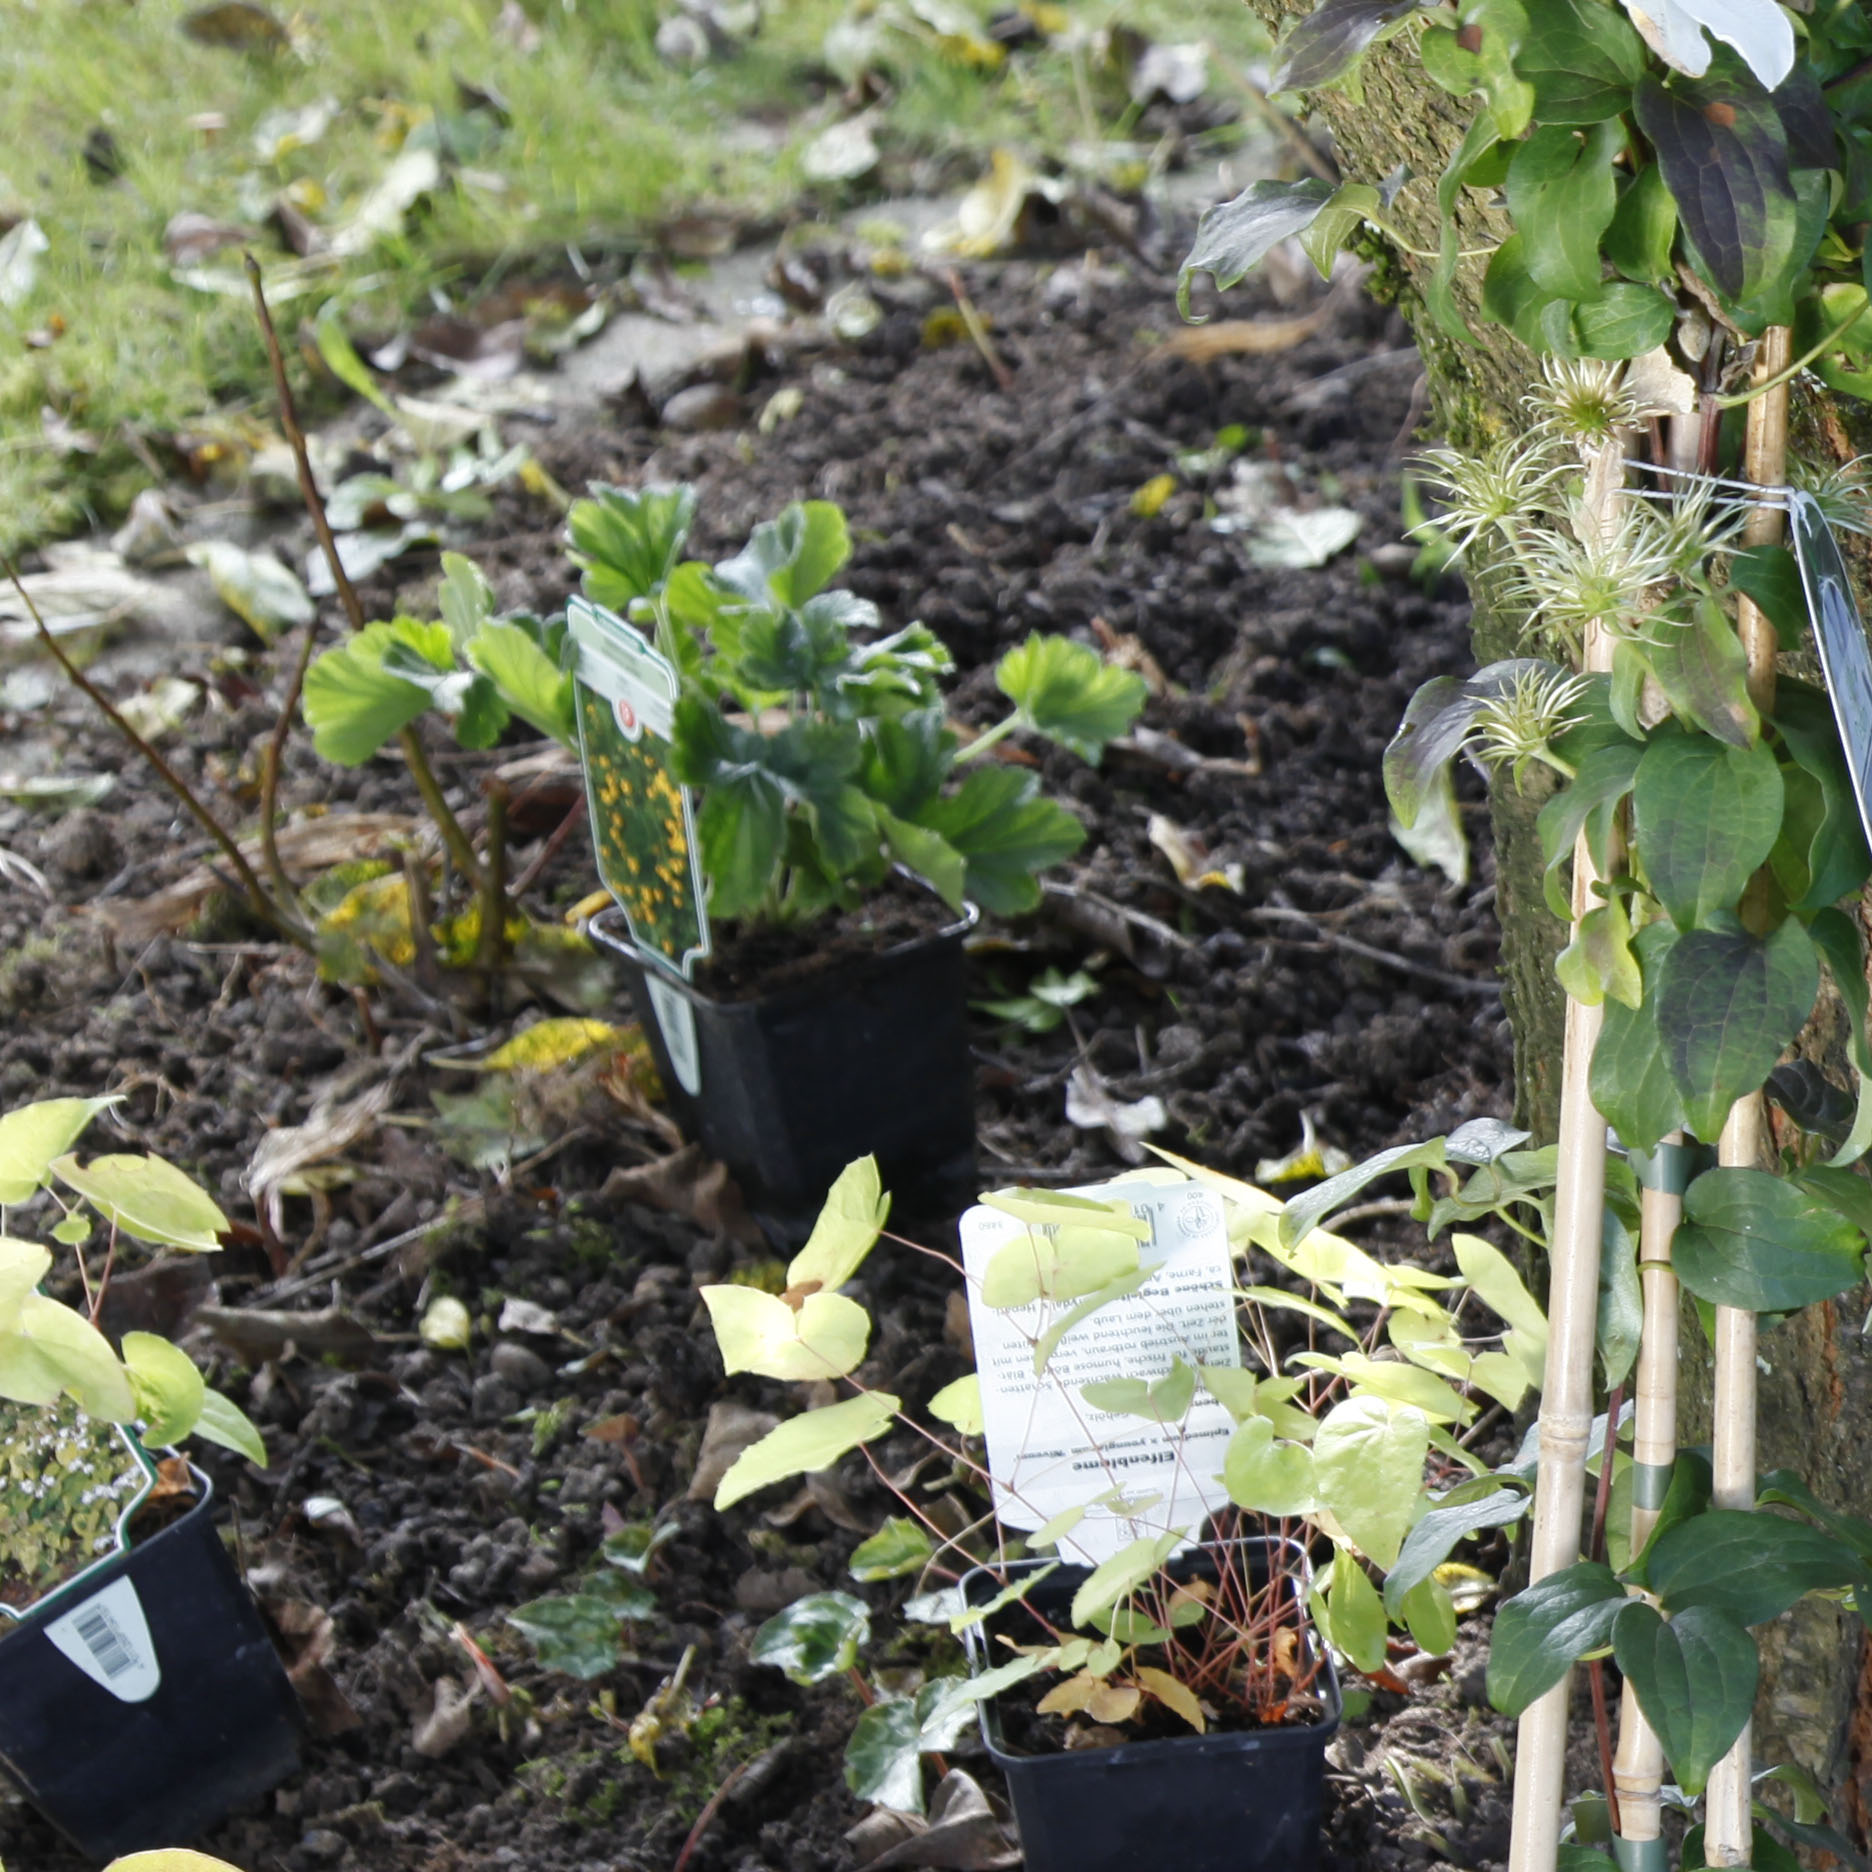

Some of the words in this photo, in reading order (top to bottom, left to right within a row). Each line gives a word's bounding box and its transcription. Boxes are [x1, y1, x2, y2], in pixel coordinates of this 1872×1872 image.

[1185, 1300, 1225, 1314] stehen
[1125, 1310, 1151, 1322] dem
[1073, 1358, 1120, 1373] humose
